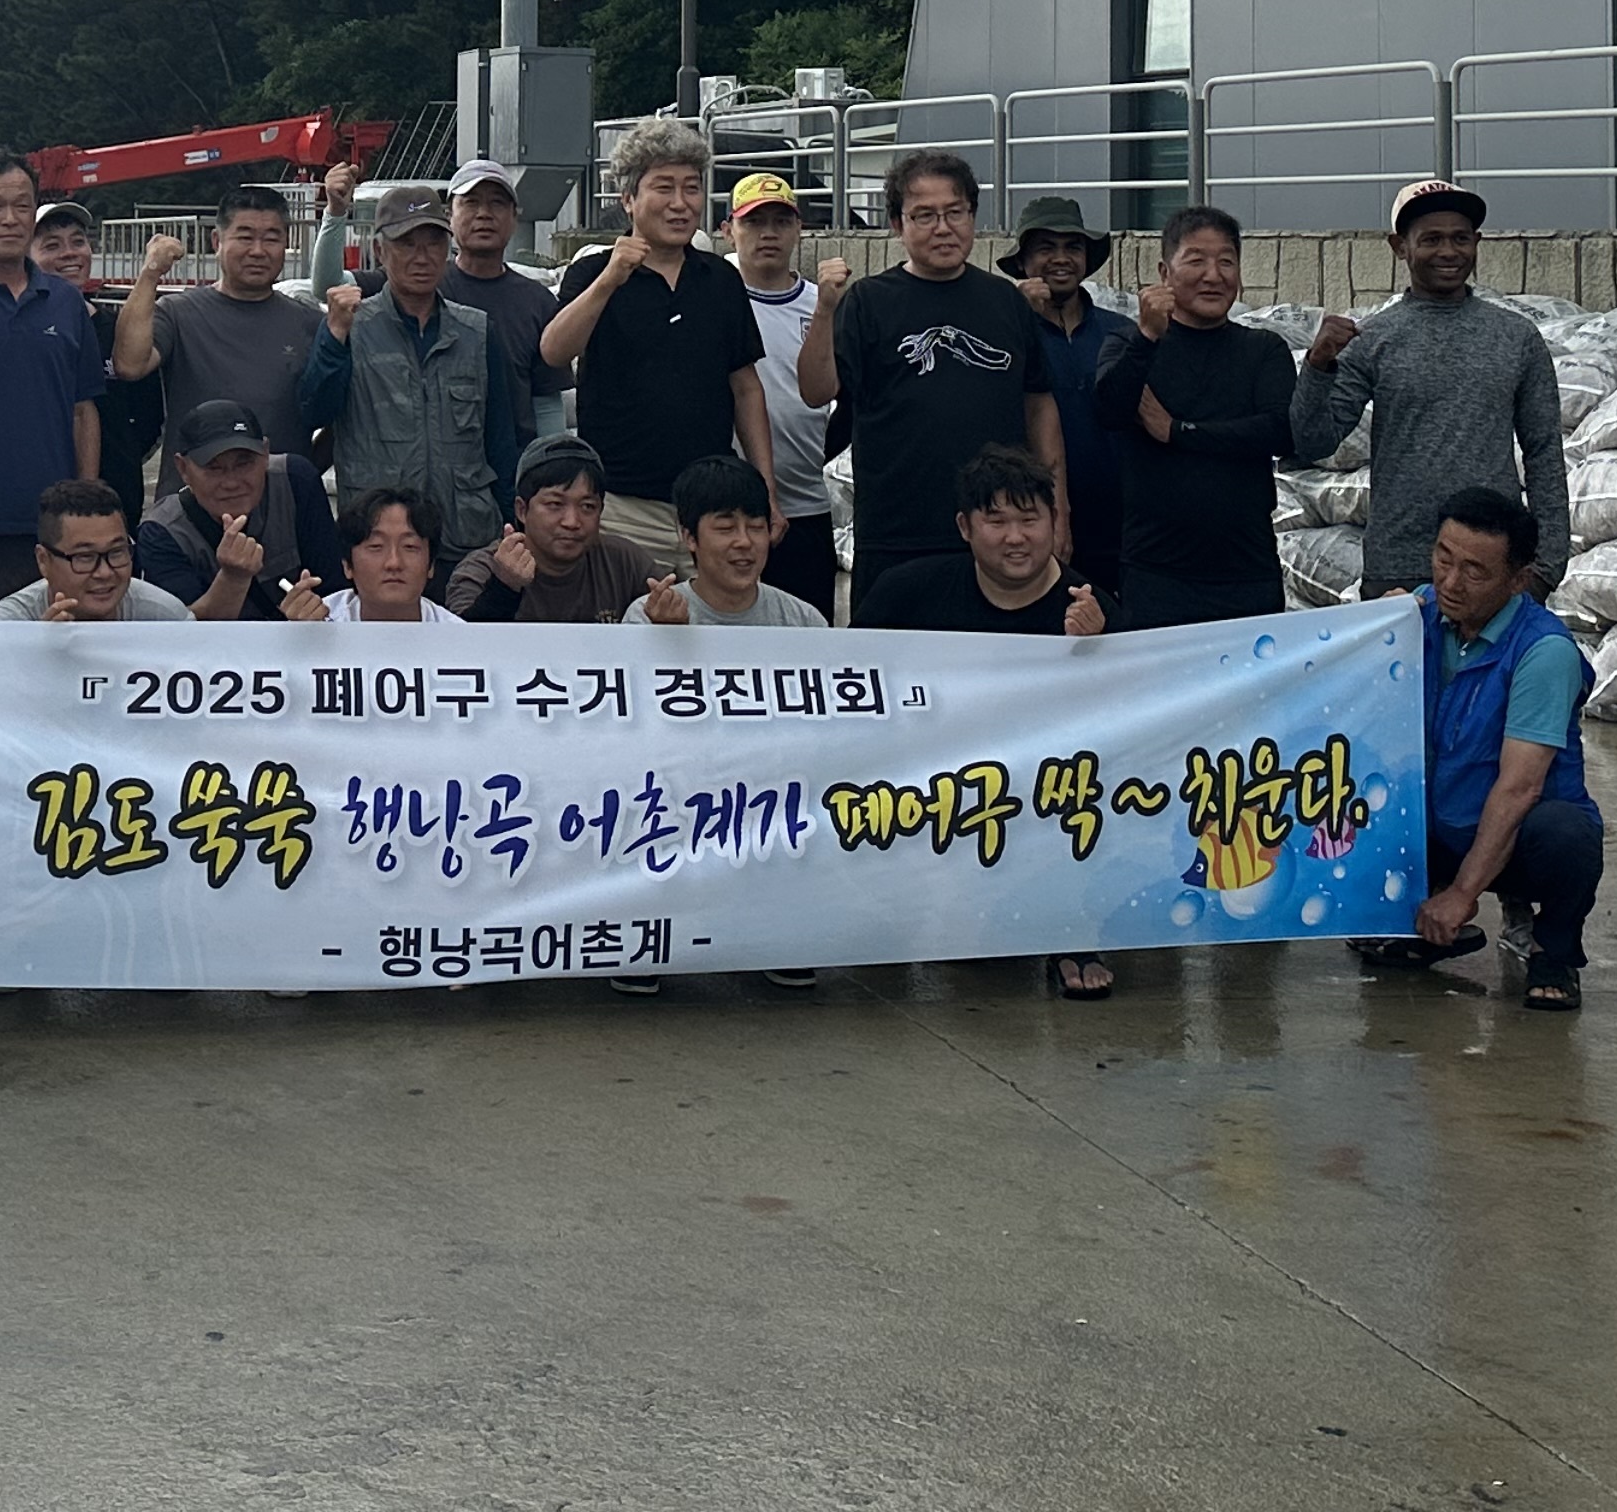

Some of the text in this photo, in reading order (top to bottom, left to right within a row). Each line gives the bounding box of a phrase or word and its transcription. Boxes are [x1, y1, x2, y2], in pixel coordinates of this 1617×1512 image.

[125, 670, 286, 717] 2025
[310, 667, 490, 719] 폐어구
[514, 667, 629, 719] 수거
[653, 667, 886, 719] 경진대회
[342, 773, 531, 878] 행낭곡
[559, 771, 809, 871] 어촌계가
[828, 760, 1022, 868] 폐어구
[1180, 733, 1369, 848] 치운다.
[379, 916, 672, 979] 행낭곡어촌계
